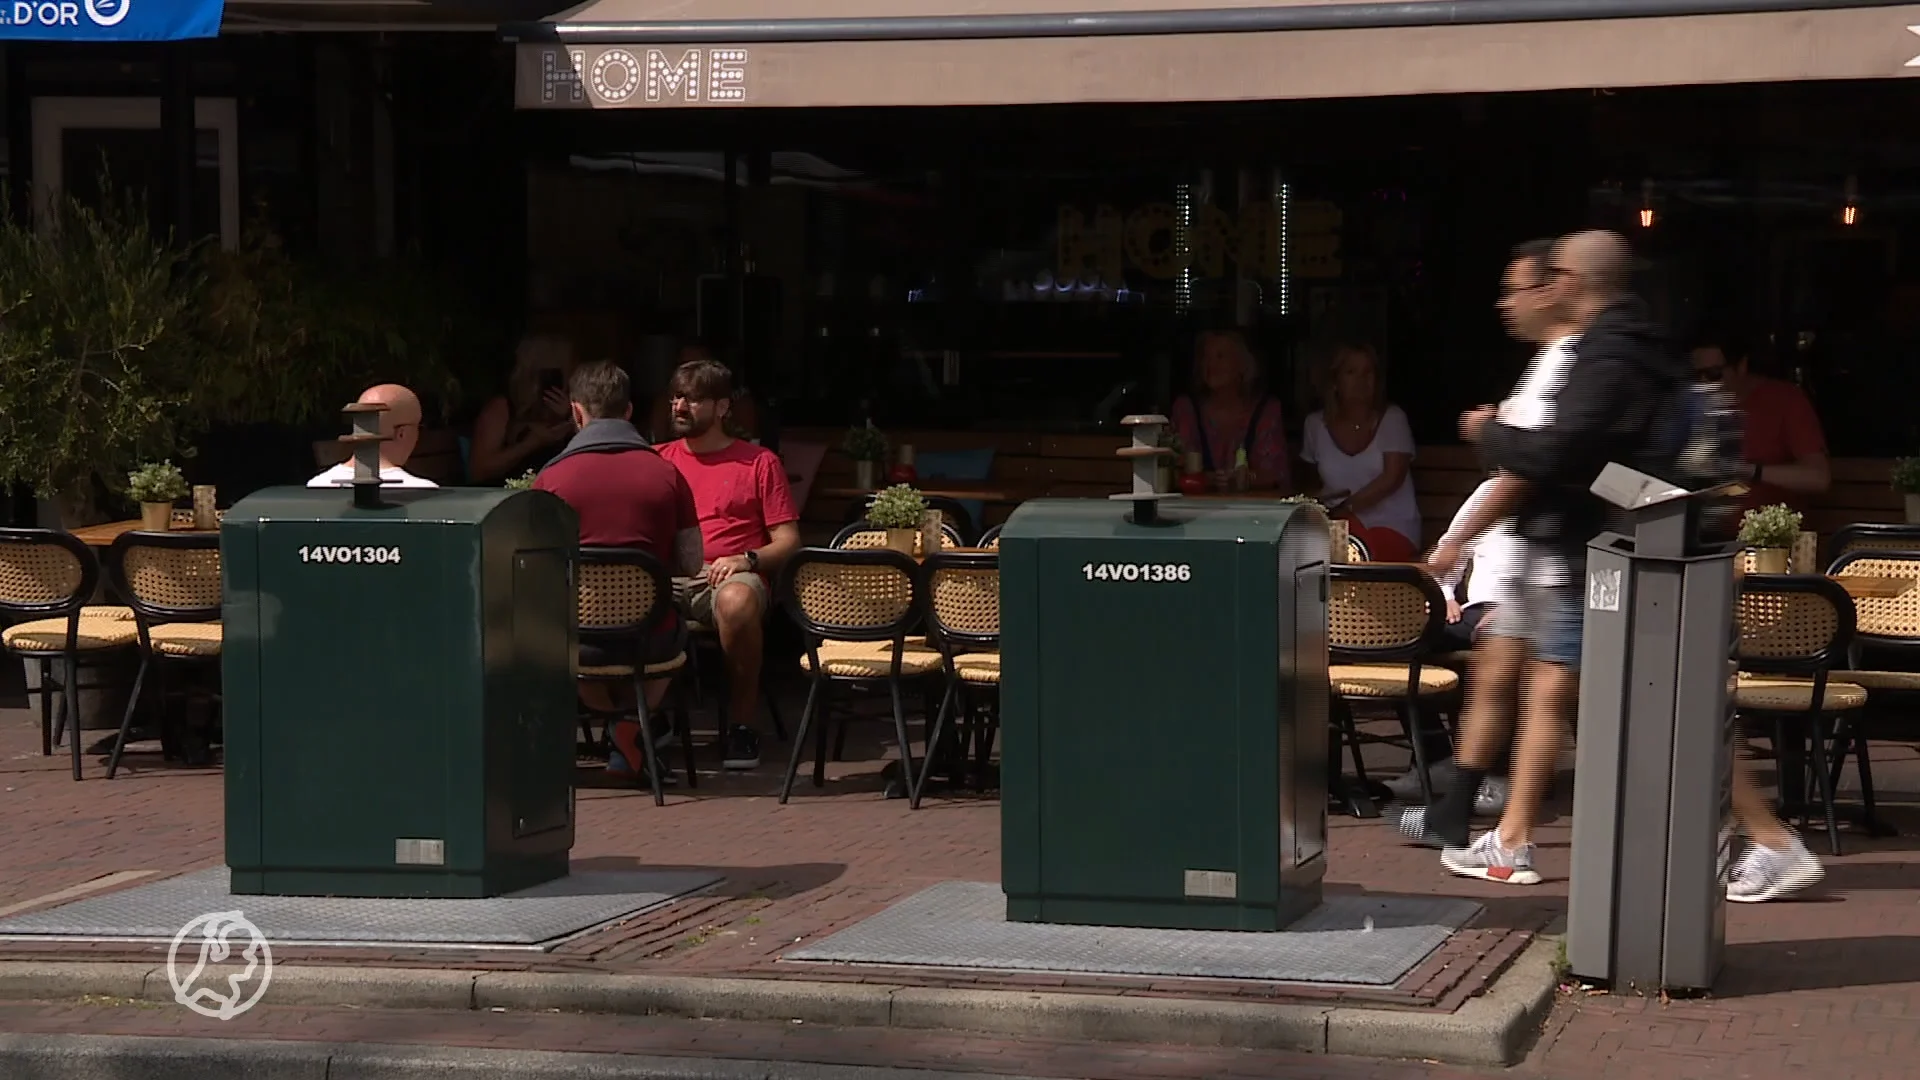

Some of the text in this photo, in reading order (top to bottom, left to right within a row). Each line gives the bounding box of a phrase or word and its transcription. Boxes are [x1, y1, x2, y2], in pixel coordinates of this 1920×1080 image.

[13, 1, 79, 26] D'OR
[542, 49, 748, 102] HOME
[1057, 200, 1343, 282] HOME
